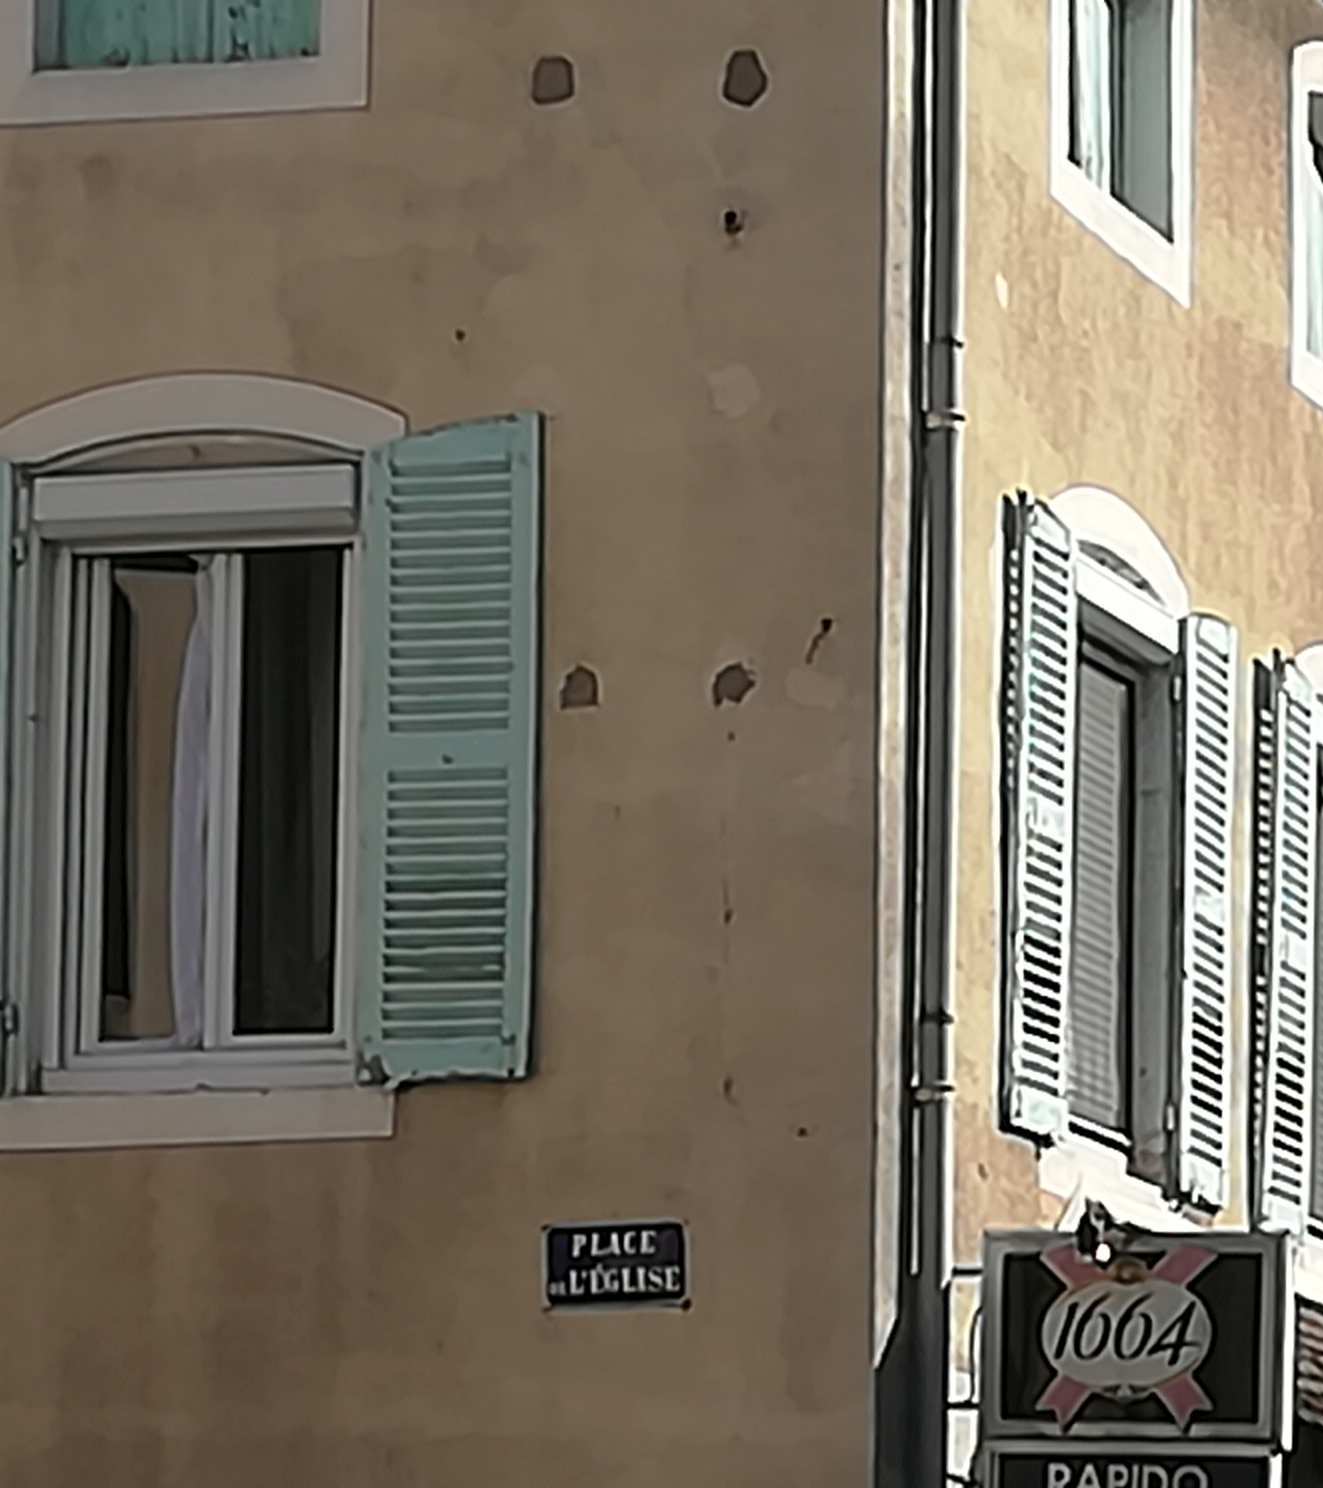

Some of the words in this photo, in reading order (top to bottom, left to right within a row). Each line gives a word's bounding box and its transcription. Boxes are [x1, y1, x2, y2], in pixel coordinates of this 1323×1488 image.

[571, 1230, 657, 1258] PLACE
[569, 1263, 681, 1295] L'ÉGLISE
[1053, 1291, 1201, 1367] 1664
